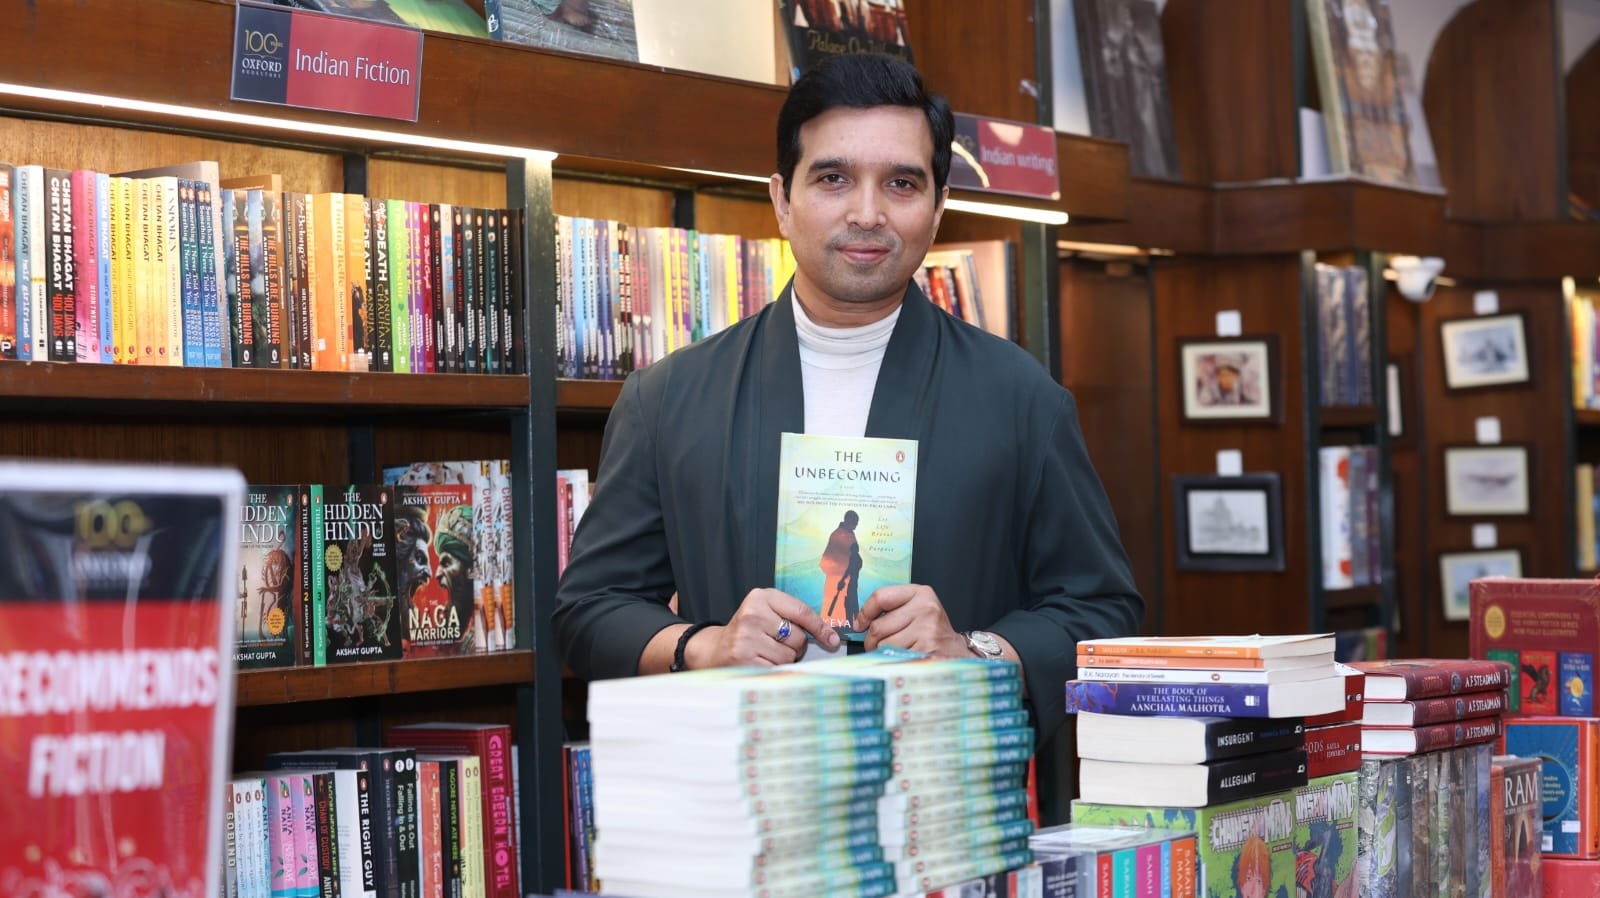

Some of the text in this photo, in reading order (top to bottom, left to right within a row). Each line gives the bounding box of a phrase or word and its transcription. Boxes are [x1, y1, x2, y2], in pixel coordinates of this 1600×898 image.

[245, 30, 278, 54] 100
[242, 58, 282, 72] OXFORD
[296, 49, 410, 85] Indian Fiction
[981, 146, 1055, 176] Indian writing
[51, 177, 63, 336] CHETAN BHAGAT 400 DAYS
[62, 178, 75, 336] CHETAN BHAGAT 400 DAYS
[377, 230, 387, 281] DEATH
[240, 235, 252, 344] THE HILLS ARE BURNING
[268, 235, 280, 344] THE HILLS ARE BURNING
[22, 284, 30, 338] girlfriend
[376, 284, 385, 348] CHAUHAN
[834, 451, 863, 463] THE
[795, 466, 901, 483] UNBECOMING
[249, 494, 267, 503] THE
[344, 492, 362, 502] THE
[402, 495, 461, 505] AKSHAT GUPTA
[240, 506, 288, 522] IDDEN
[324, 504, 384, 520] HIDDEN
[240, 524, 288, 543] INDU
[324, 521, 384, 541] HINDU
[304, 592, 309, 601] 2
[317, 592, 322, 600] 3
[409, 605, 460, 628] NAGA
[409, 627, 460, 640] WARRIORS
[232, 651, 277, 662] AKSHAT GUPTA
[336, 646, 383, 657] AKSHAT GUPTA
[1474, 672, 1501, 686] STEADMAN
[1136, 694, 1191, 702] EVERLASTING
[1476, 696, 1501, 711] STEADMAN
[1130, 704, 1231, 713] AANCHAL MALHOTRA
[1474, 723, 1496, 738] STEADMAN
[1217, 732, 1254, 747] INSURGENT
[27, 729, 166, 797] FICTION
[1220, 772, 1256, 789] ALLEGIANT
[1504, 771, 1538, 808] RAM
[398, 816, 405, 824] In
[408, 814, 414, 823] In
[489, 735, 509, 889] GREAT EASTERN HOTEL
[227, 812, 235, 867] GOBIND
[319, 801, 330, 870] CHAIN OF CUSTODY
[360, 792, 373, 886] THE RIGHT GUY
